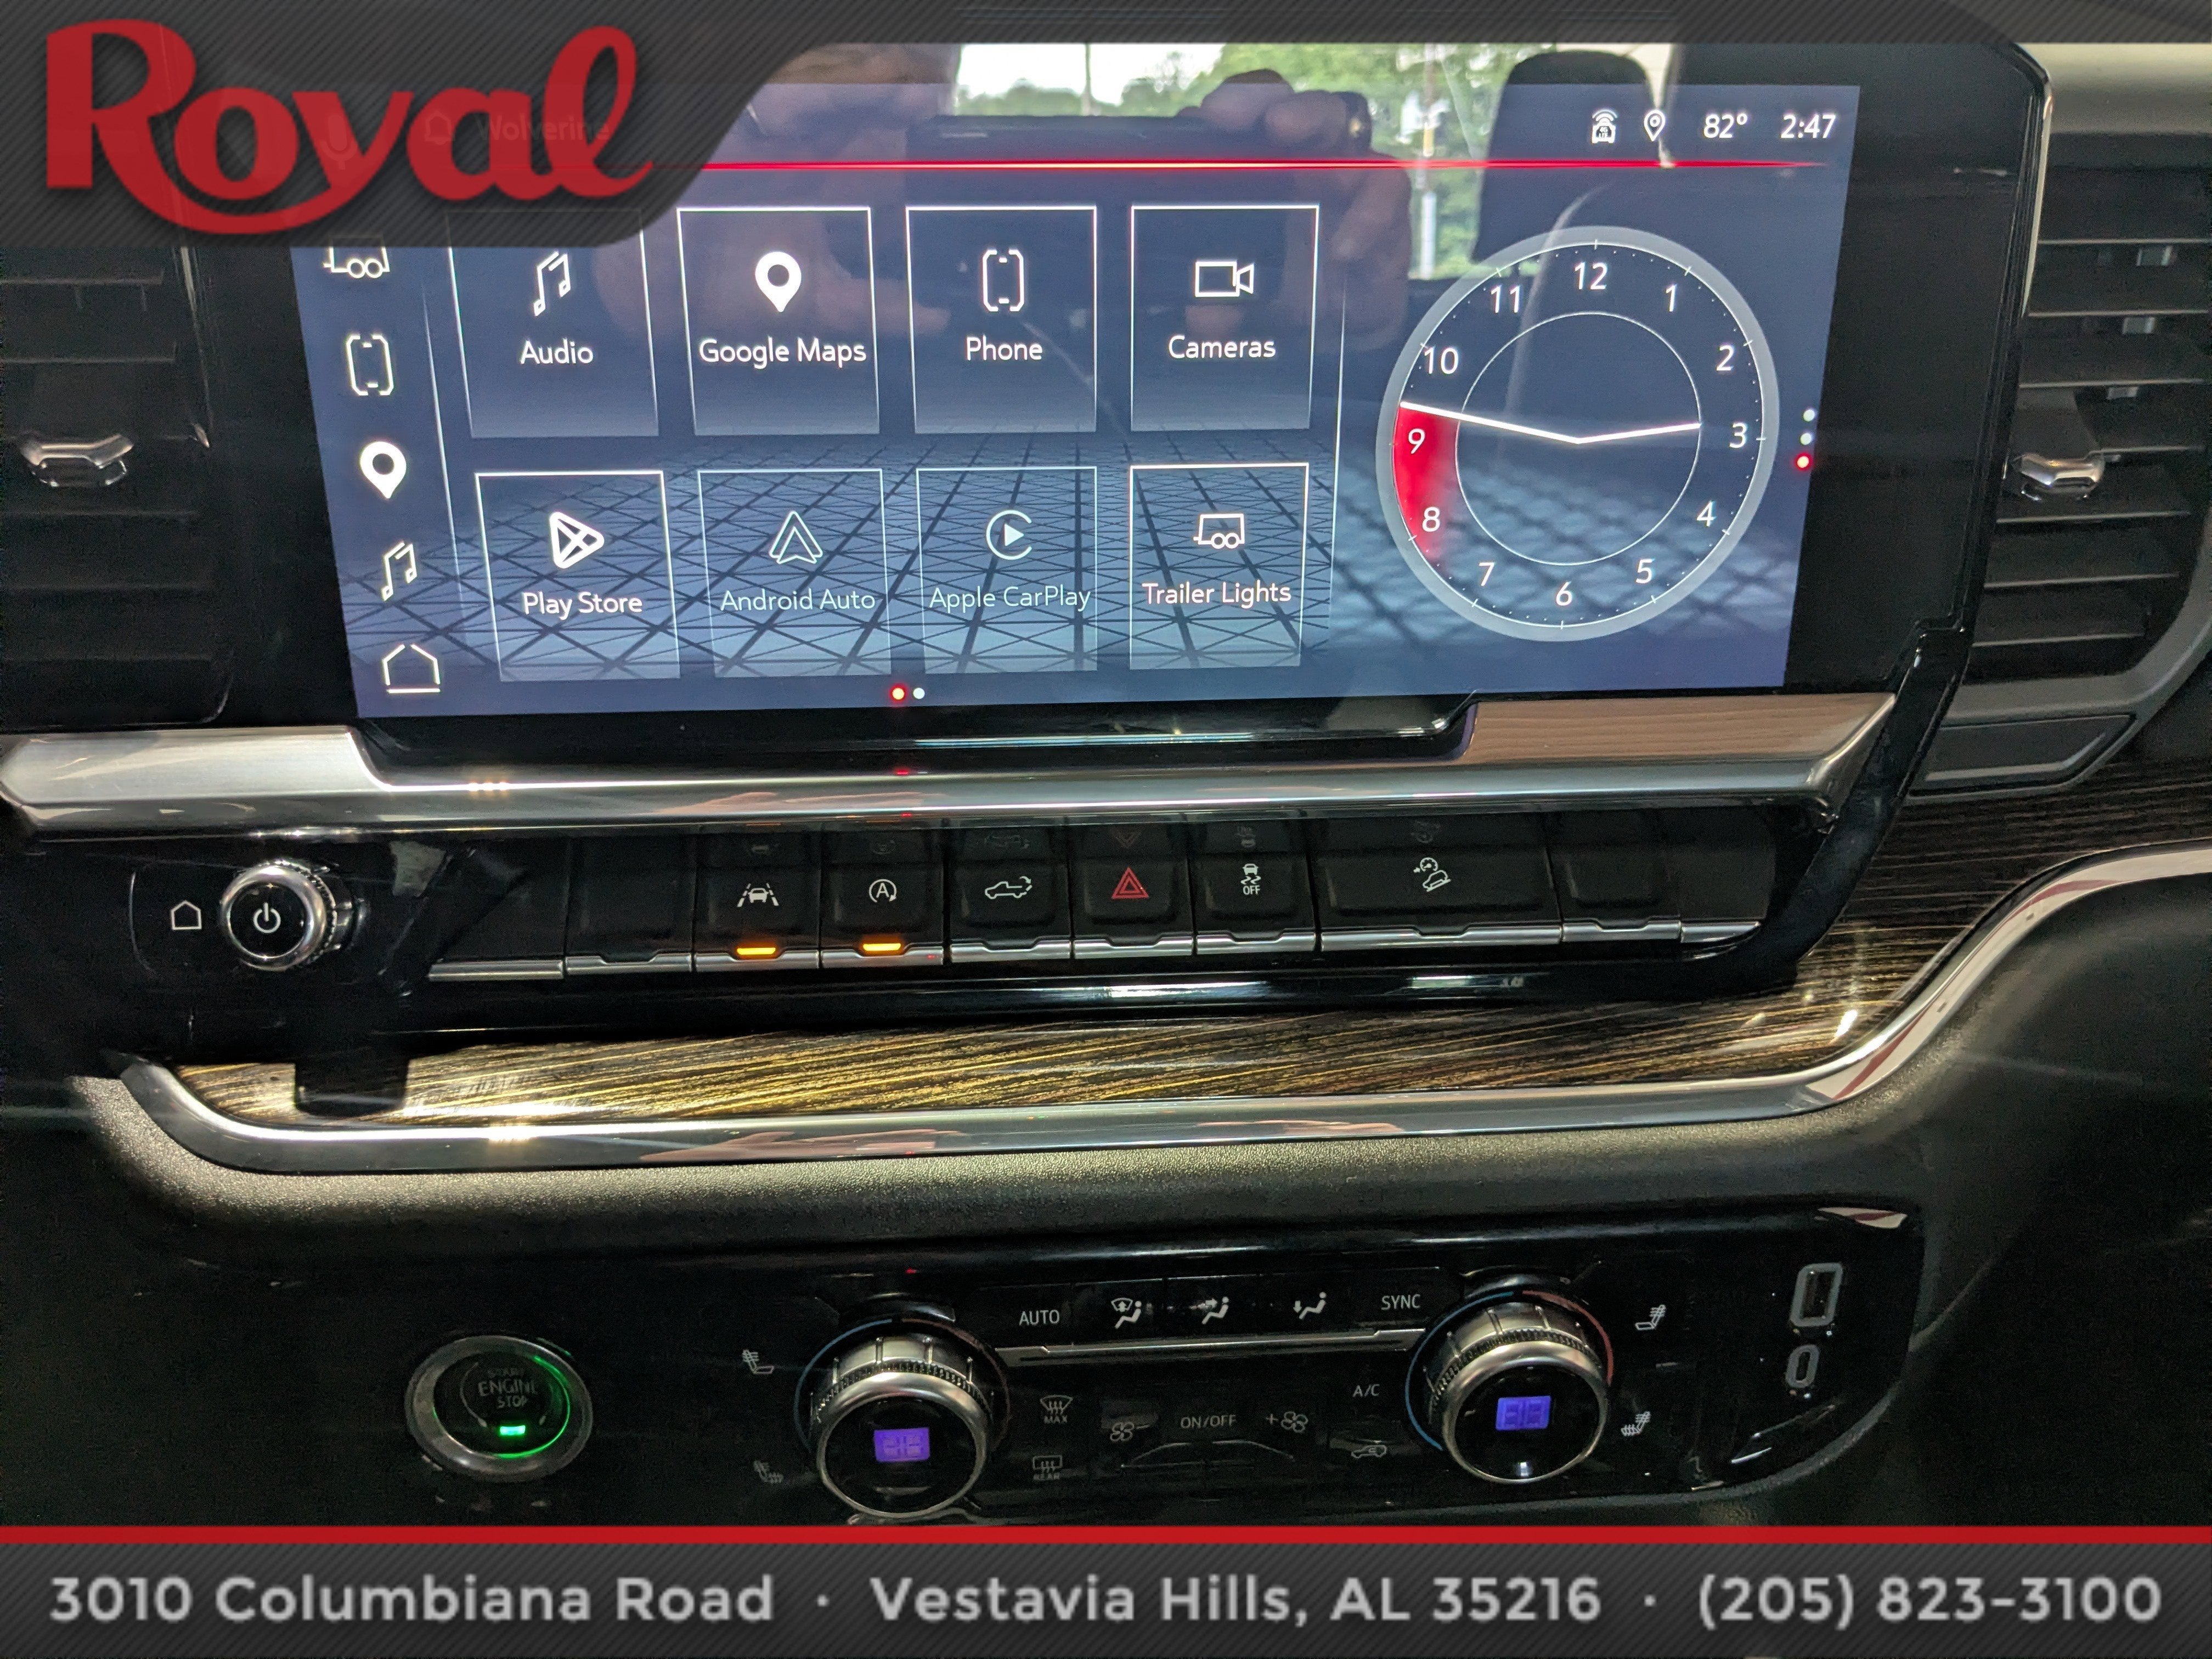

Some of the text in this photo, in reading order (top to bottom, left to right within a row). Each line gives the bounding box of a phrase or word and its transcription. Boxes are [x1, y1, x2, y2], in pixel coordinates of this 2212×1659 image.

[475, 115, 610, 140] Wolverine
[1780, 114, 1836, 139] 2:47
[1573, 262, 1608, 290] 12
[1490, 284, 1521, 314] 11
[1664, 284, 1678, 313] 1
[520, 338, 594, 365] Audio
[699, 337, 867, 369] Google Maps
[966, 335, 1043, 361] Phone
[1169, 335, 1276, 359] Cameras
[1716, 346, 1735, 372] 2
[1423, 346, 1460, 375] 10
[1408, 429, 1426, 454] 9
[1729, 422, 1748, 448] 3
[1422, 506, 1441, 532] 8
[1696, 500, 1716, 527] 4
[1478, 562, 1496, 586] 7
[1635, 558, 1655, 584] 5
[523, 591, 642, 620] Play Store
[720, 589, 876, 611] Android Auto
[929, 584, 1091, 613] Apple CarPlay
[1142, 579, 1292, 610] Trailer Lights
[1555, 583, 1573, 606] 6
[1243, 885, 1261, 895] OFF
[1381, 1294, 1421, 1311] SYNC
[1019, 1310, 1060, 1326] AUTO
[478, 1378, 538, 1397] ENGINE
[1352, 1384, 1380, 1398] A/C
[496, 1395, 528, 1409] STOP
[1043, 1415, 1068, 1424] MAX
[1180, 1415, 1236, 1429] ON/OFF
